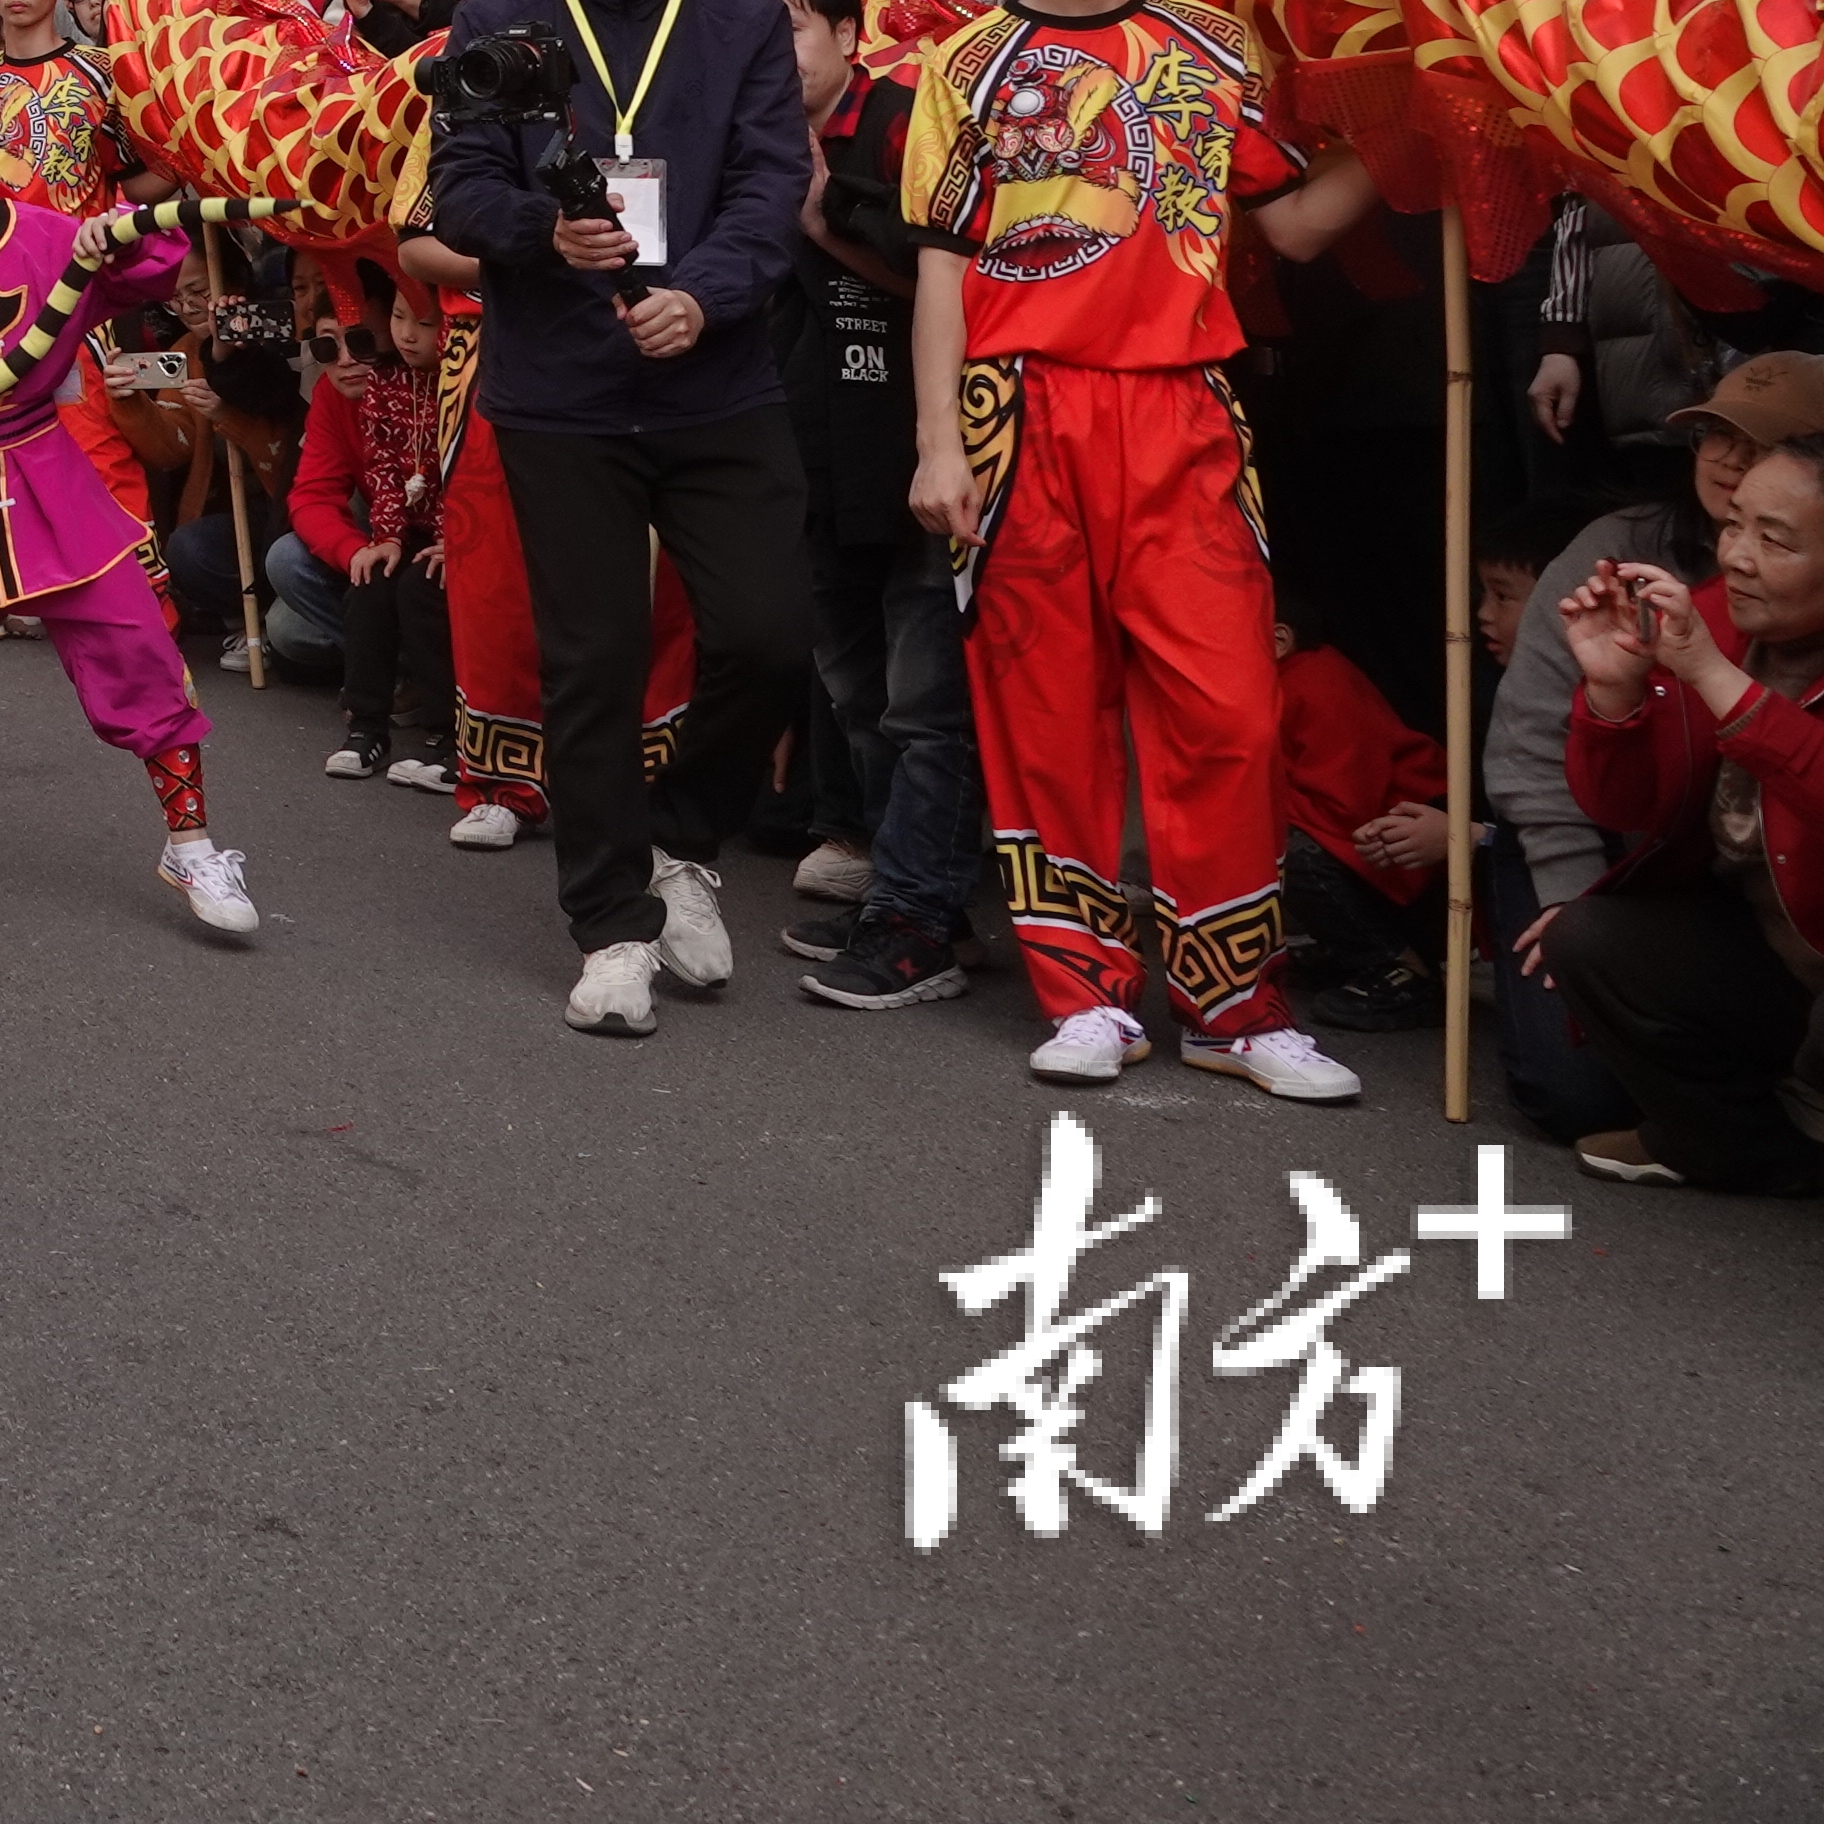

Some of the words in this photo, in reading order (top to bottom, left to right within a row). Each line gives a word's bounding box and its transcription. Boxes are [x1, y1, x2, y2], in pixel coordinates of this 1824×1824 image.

[835, 317, 888, 334] STREET
[845, 344, 886, 370] ON
[841, 368, 889, 383] BLACK
